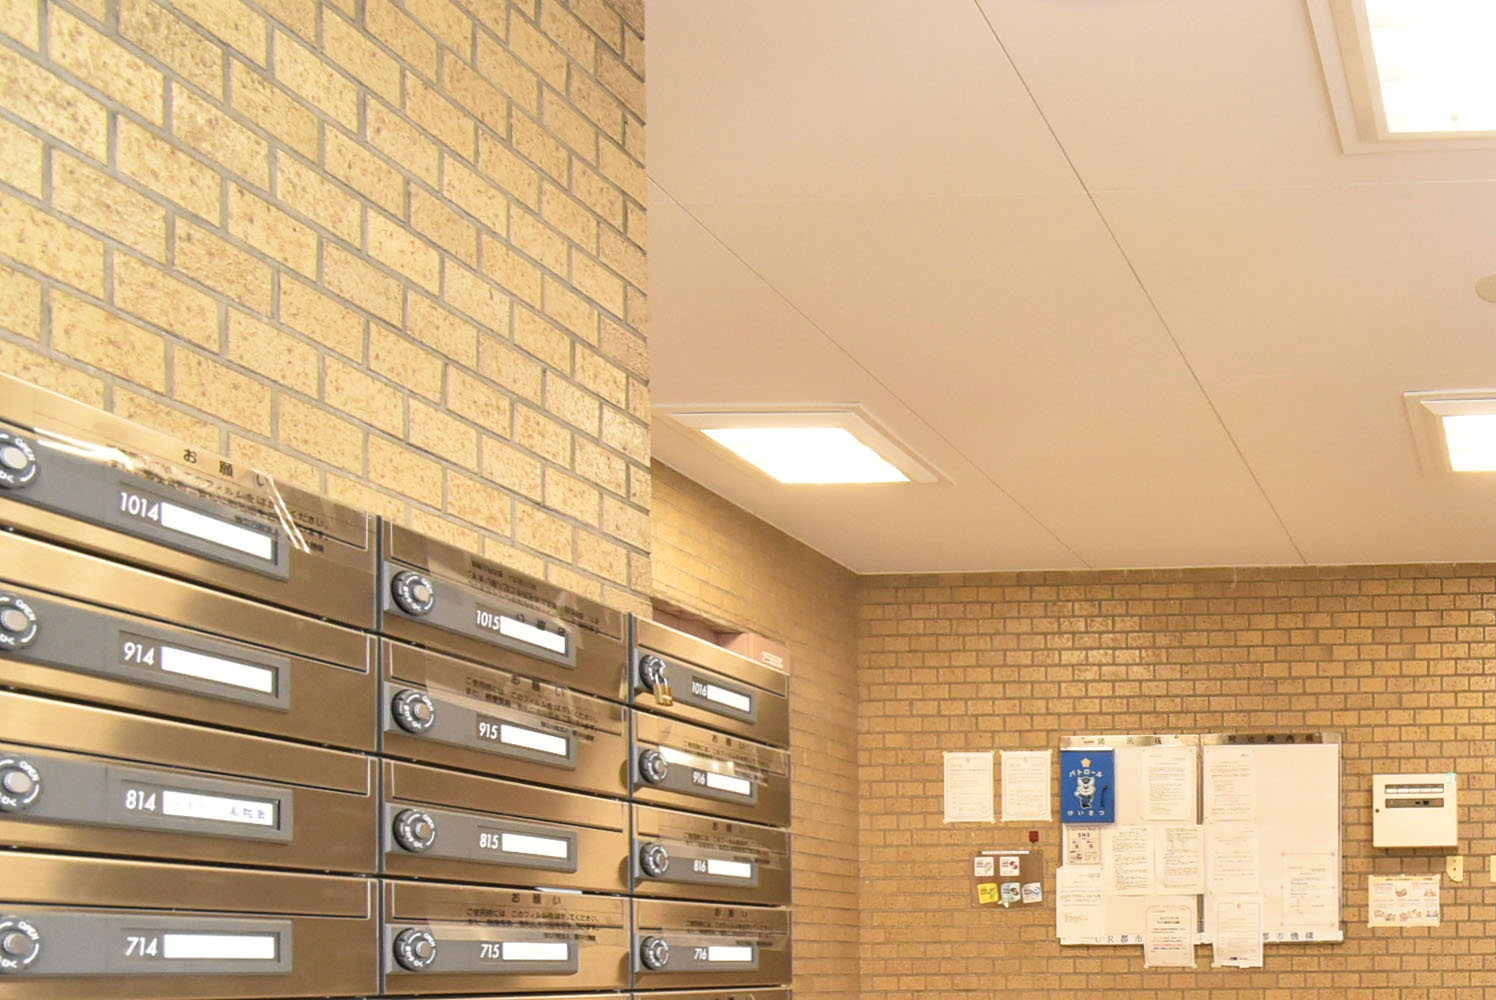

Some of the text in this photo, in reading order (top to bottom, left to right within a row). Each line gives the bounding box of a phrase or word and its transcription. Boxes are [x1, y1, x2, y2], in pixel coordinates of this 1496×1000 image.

[15, 437, 36, 461] OPEN
[120, 493, 159, 521] 1014
[15, 599, 37, 621] OPEN
[476, 610, 500, 630] 1015
[123, 642, 155, 666] 914
[479, 722, 498, 739] 915
[20, 761, 41, 782] OPEN
[1069, 768, 1104, 778] パトロール
[124, 789, 156, 812] 814
[479, 833, 499, 850] 815
[18, 920, 40, 941] OPEN
[125, 937, 158, 956] 714
[480, 944, 500, 959] 715
